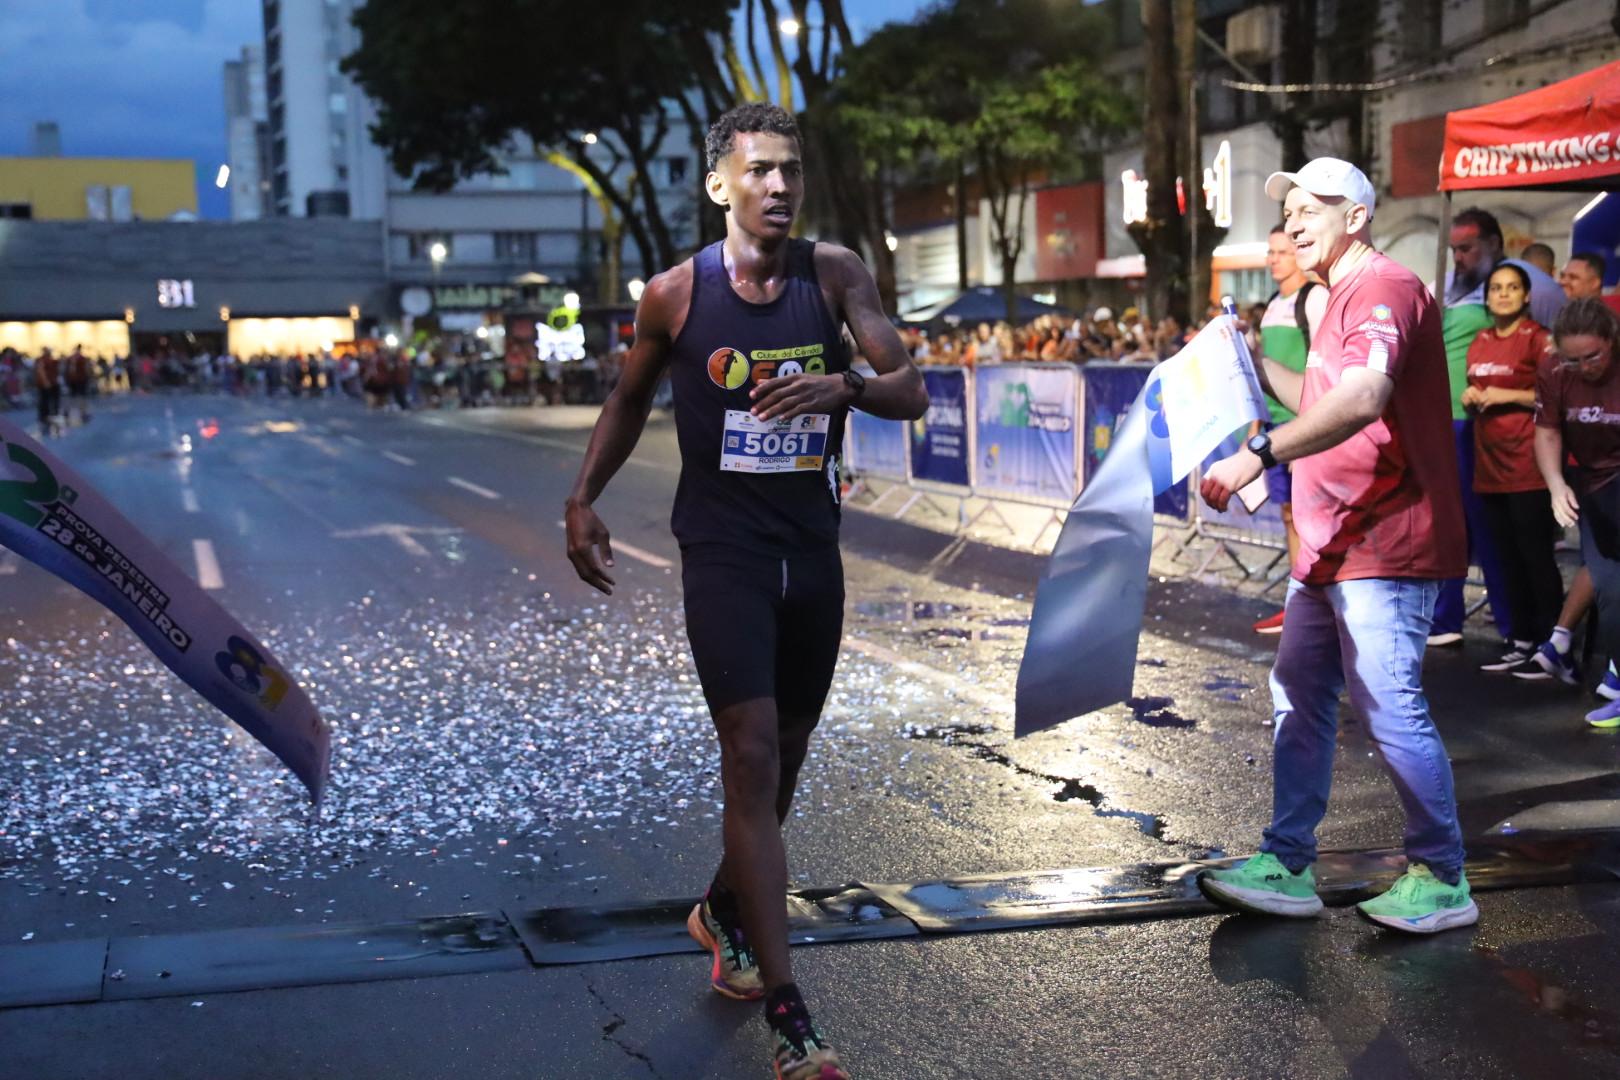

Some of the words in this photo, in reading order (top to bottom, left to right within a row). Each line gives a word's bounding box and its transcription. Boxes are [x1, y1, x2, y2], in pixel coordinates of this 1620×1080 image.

[1453, 132, 1610, 178] CHIPTIMING
[744, 433, 810, 455] 5061
[759, 456, 790, 464] RODRIGO
[55, 505, 103, 547] PROVA
[103, 545, 168, 605] PEDESTRE
[42, 517, 75, 546] 28
[75, 542, 96, 563] de
[96, 563, 188, 649] JANEIRO
